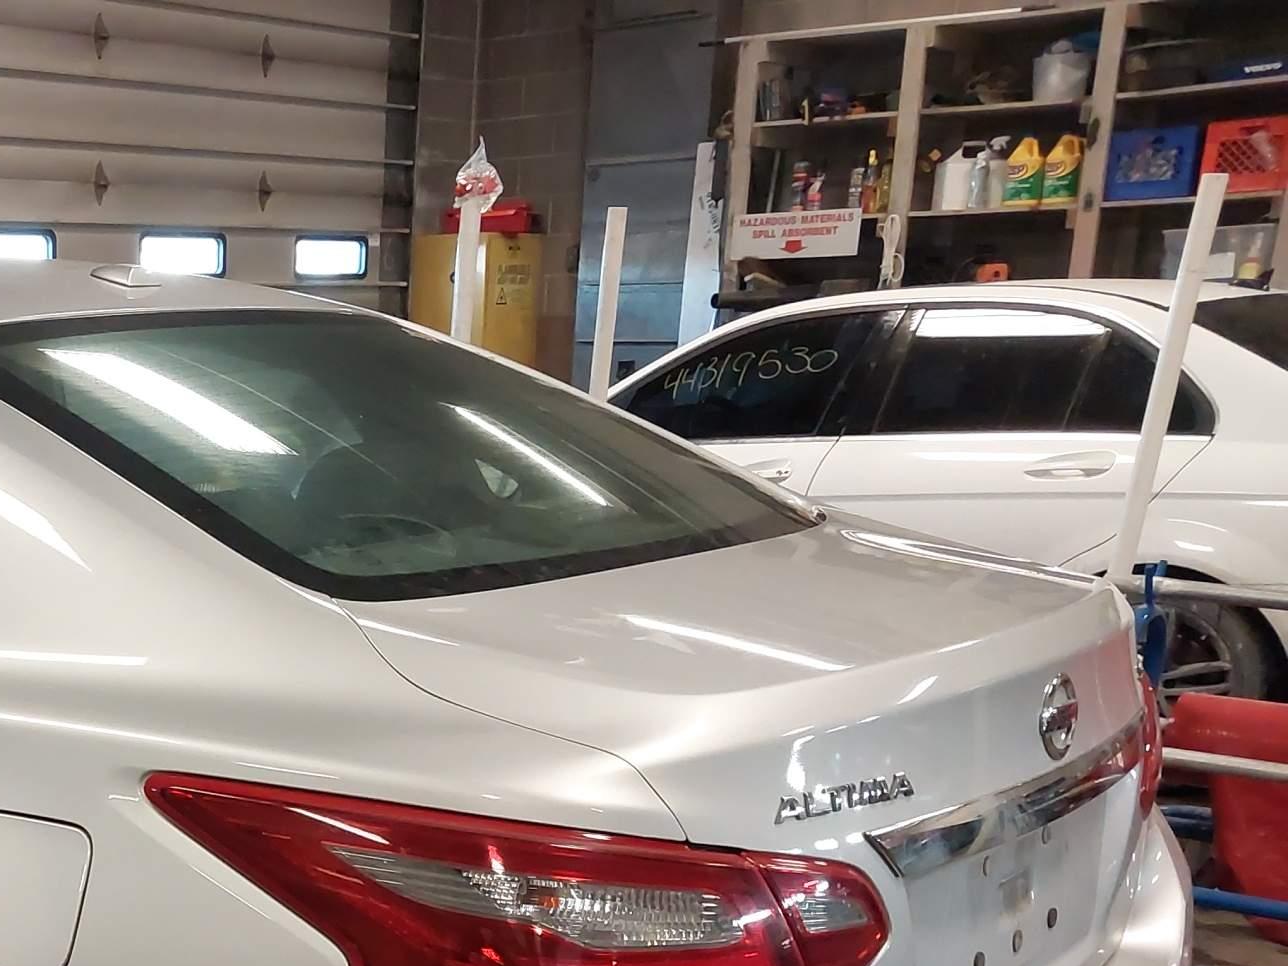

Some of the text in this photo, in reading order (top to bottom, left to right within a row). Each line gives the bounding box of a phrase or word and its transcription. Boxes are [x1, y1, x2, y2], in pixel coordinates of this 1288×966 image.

[739, 213, 854, 227] HAZARDOUS MATERIALS
[752, 226, 840, 239] SPILL ABSORBENT
[664, 346, 838, 399] 44319530
[774, 771, 915, 825] ALTIMA
